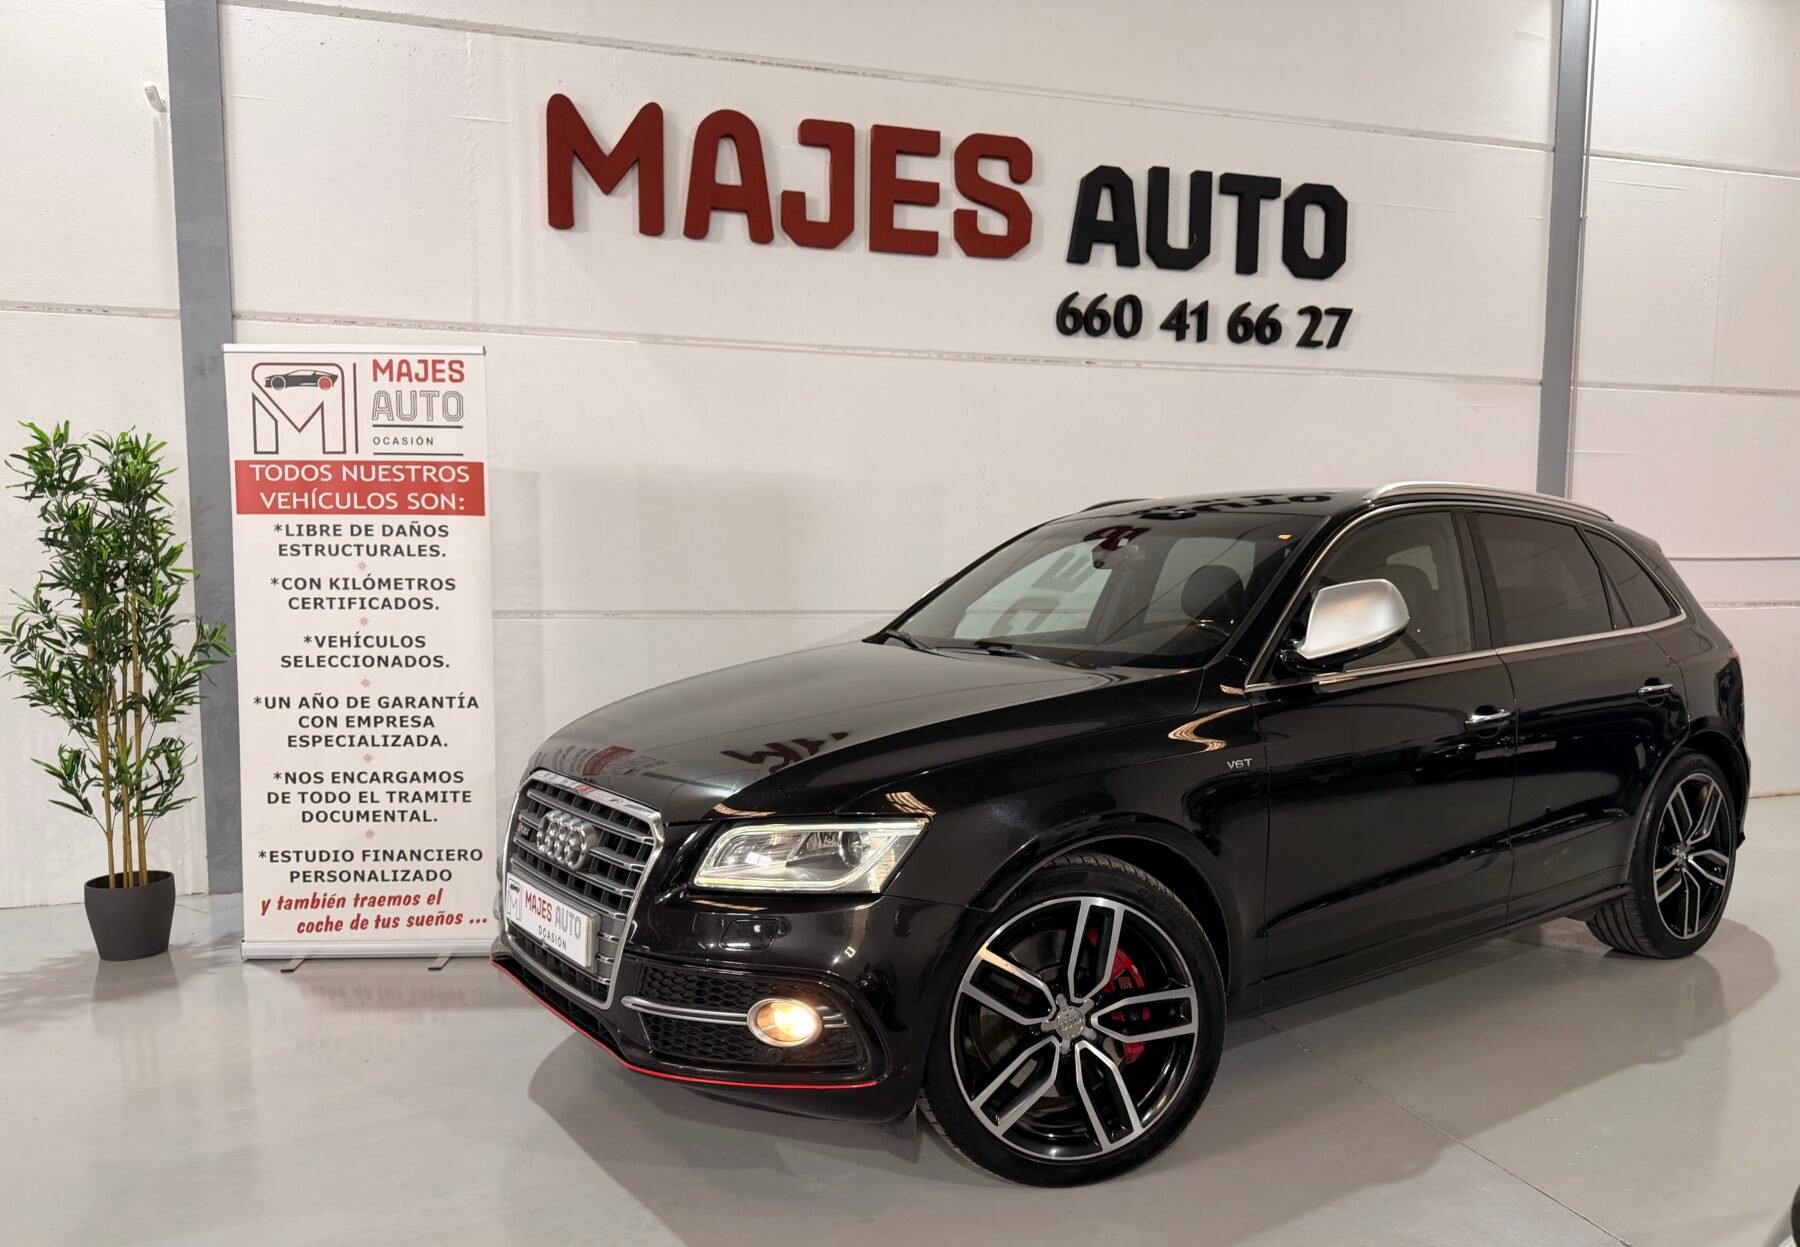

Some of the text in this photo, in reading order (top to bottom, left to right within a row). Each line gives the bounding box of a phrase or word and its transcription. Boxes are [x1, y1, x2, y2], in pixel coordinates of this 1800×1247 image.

[545, 93, 1349, 280] MAJES AUTO
[1056, 291, 1353, 348] 660 41 66 27
[372, 359, 464, 382] MAJES
[372, 391, 464, 421] AUTO
[373, 436, 434, 445] OCASIÓN
[250, 464, 470, 482] TODOS NUESTROS
[260, 488, 465, 510] VEHÍCULOS SON:
[350, 524, 374, 537] DE
[382, 520, 449, 537] DAÑOS
[278, 544, 446, 557] ESTRUCTURALES.
[330, 574, 456, 591] KILÓMETROS
[288, 597, 440, 610] CERTIFICADOS.
[280, 655, 450, 668] SELECCIONADOS.
[298, 693, 339, 709] AÑO
[346, 696, 370, 709] DE
[378, 692, 479, 709] GARANTÍA
[298, 715, 435, 728] CON EMPRESA
[287, 735, 448, 747] ESPECIALIZADA.
[1227, 758, 1252, 769] V6T
[331, 771, 464, 784] ENCARGAMOS
[267, 791, 472, 804] DE TODO EL TRAMITE
[301, 810, 438, 823] DOCUMENTAL.
[362, 849, 483, 862] FINANCIERO
[289, 869, 453, 883] PERSONALIZADO
[261, 888, 443, 915] y también traemos el
[296, 915, 343, 934] coche
[349, 914, 369, 931] de
[375, 914, 400, 930] tus
[406, 911, 463, 928] sueños
[525, 890, 581, 939] MAJES AUTO
[539, 925, 567, 951] OCASIÓN
